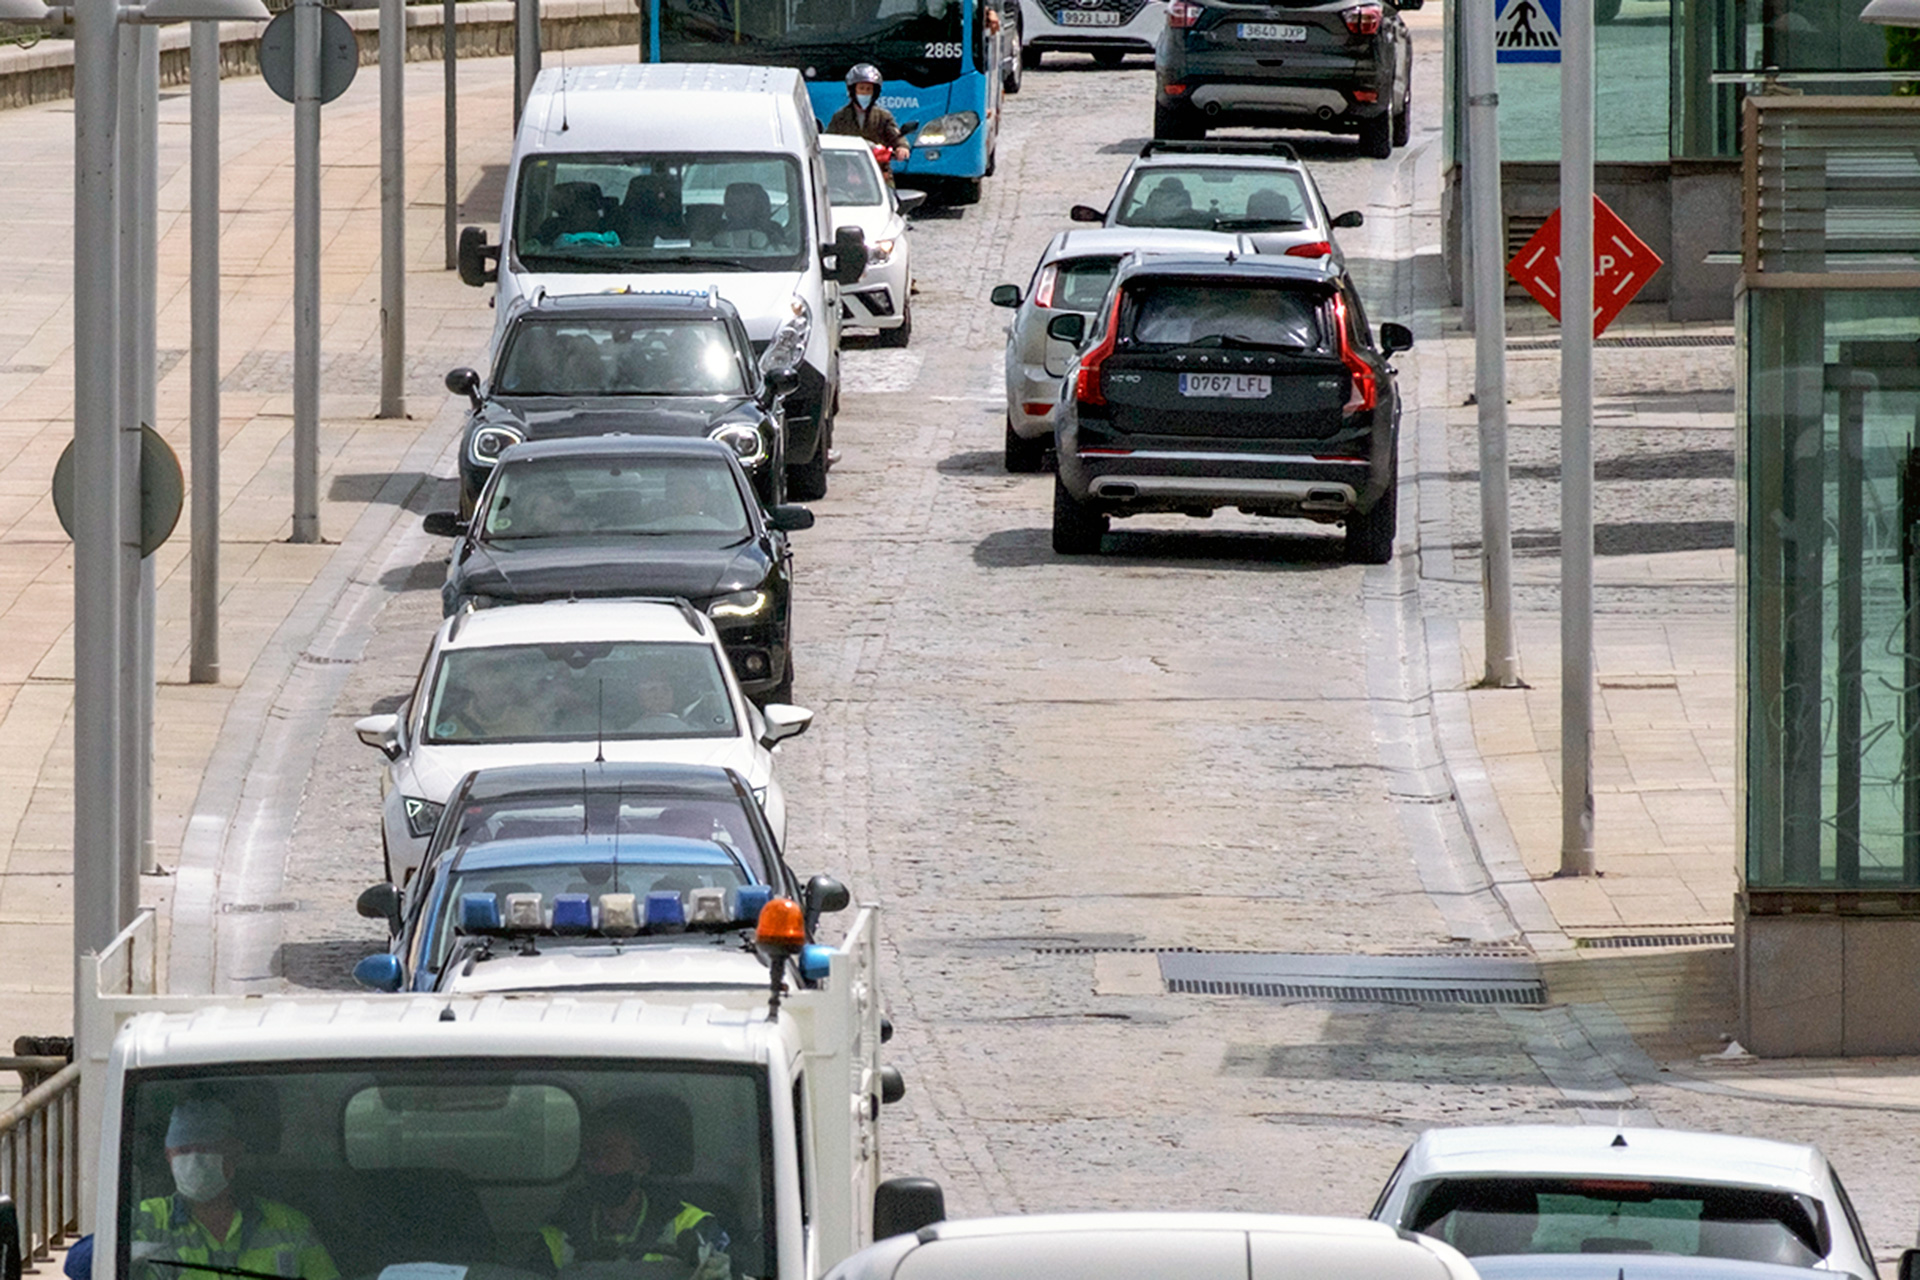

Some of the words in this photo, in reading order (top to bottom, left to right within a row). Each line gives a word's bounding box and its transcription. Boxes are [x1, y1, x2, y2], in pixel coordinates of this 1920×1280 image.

[1065, 12, 1092, 23] 9923
[1096, 13, 1118, 24] LJJ
[1246, 26, 1277, 36] 3640
[1281, 27, 1305, 37] JXP
[925, 42, 963, 58] 2865
[1176, 355, 1276, 364] VOLVO
[1190, 376, 1231, 391] 0767
[1236, 377, 1268, 392] LFL
